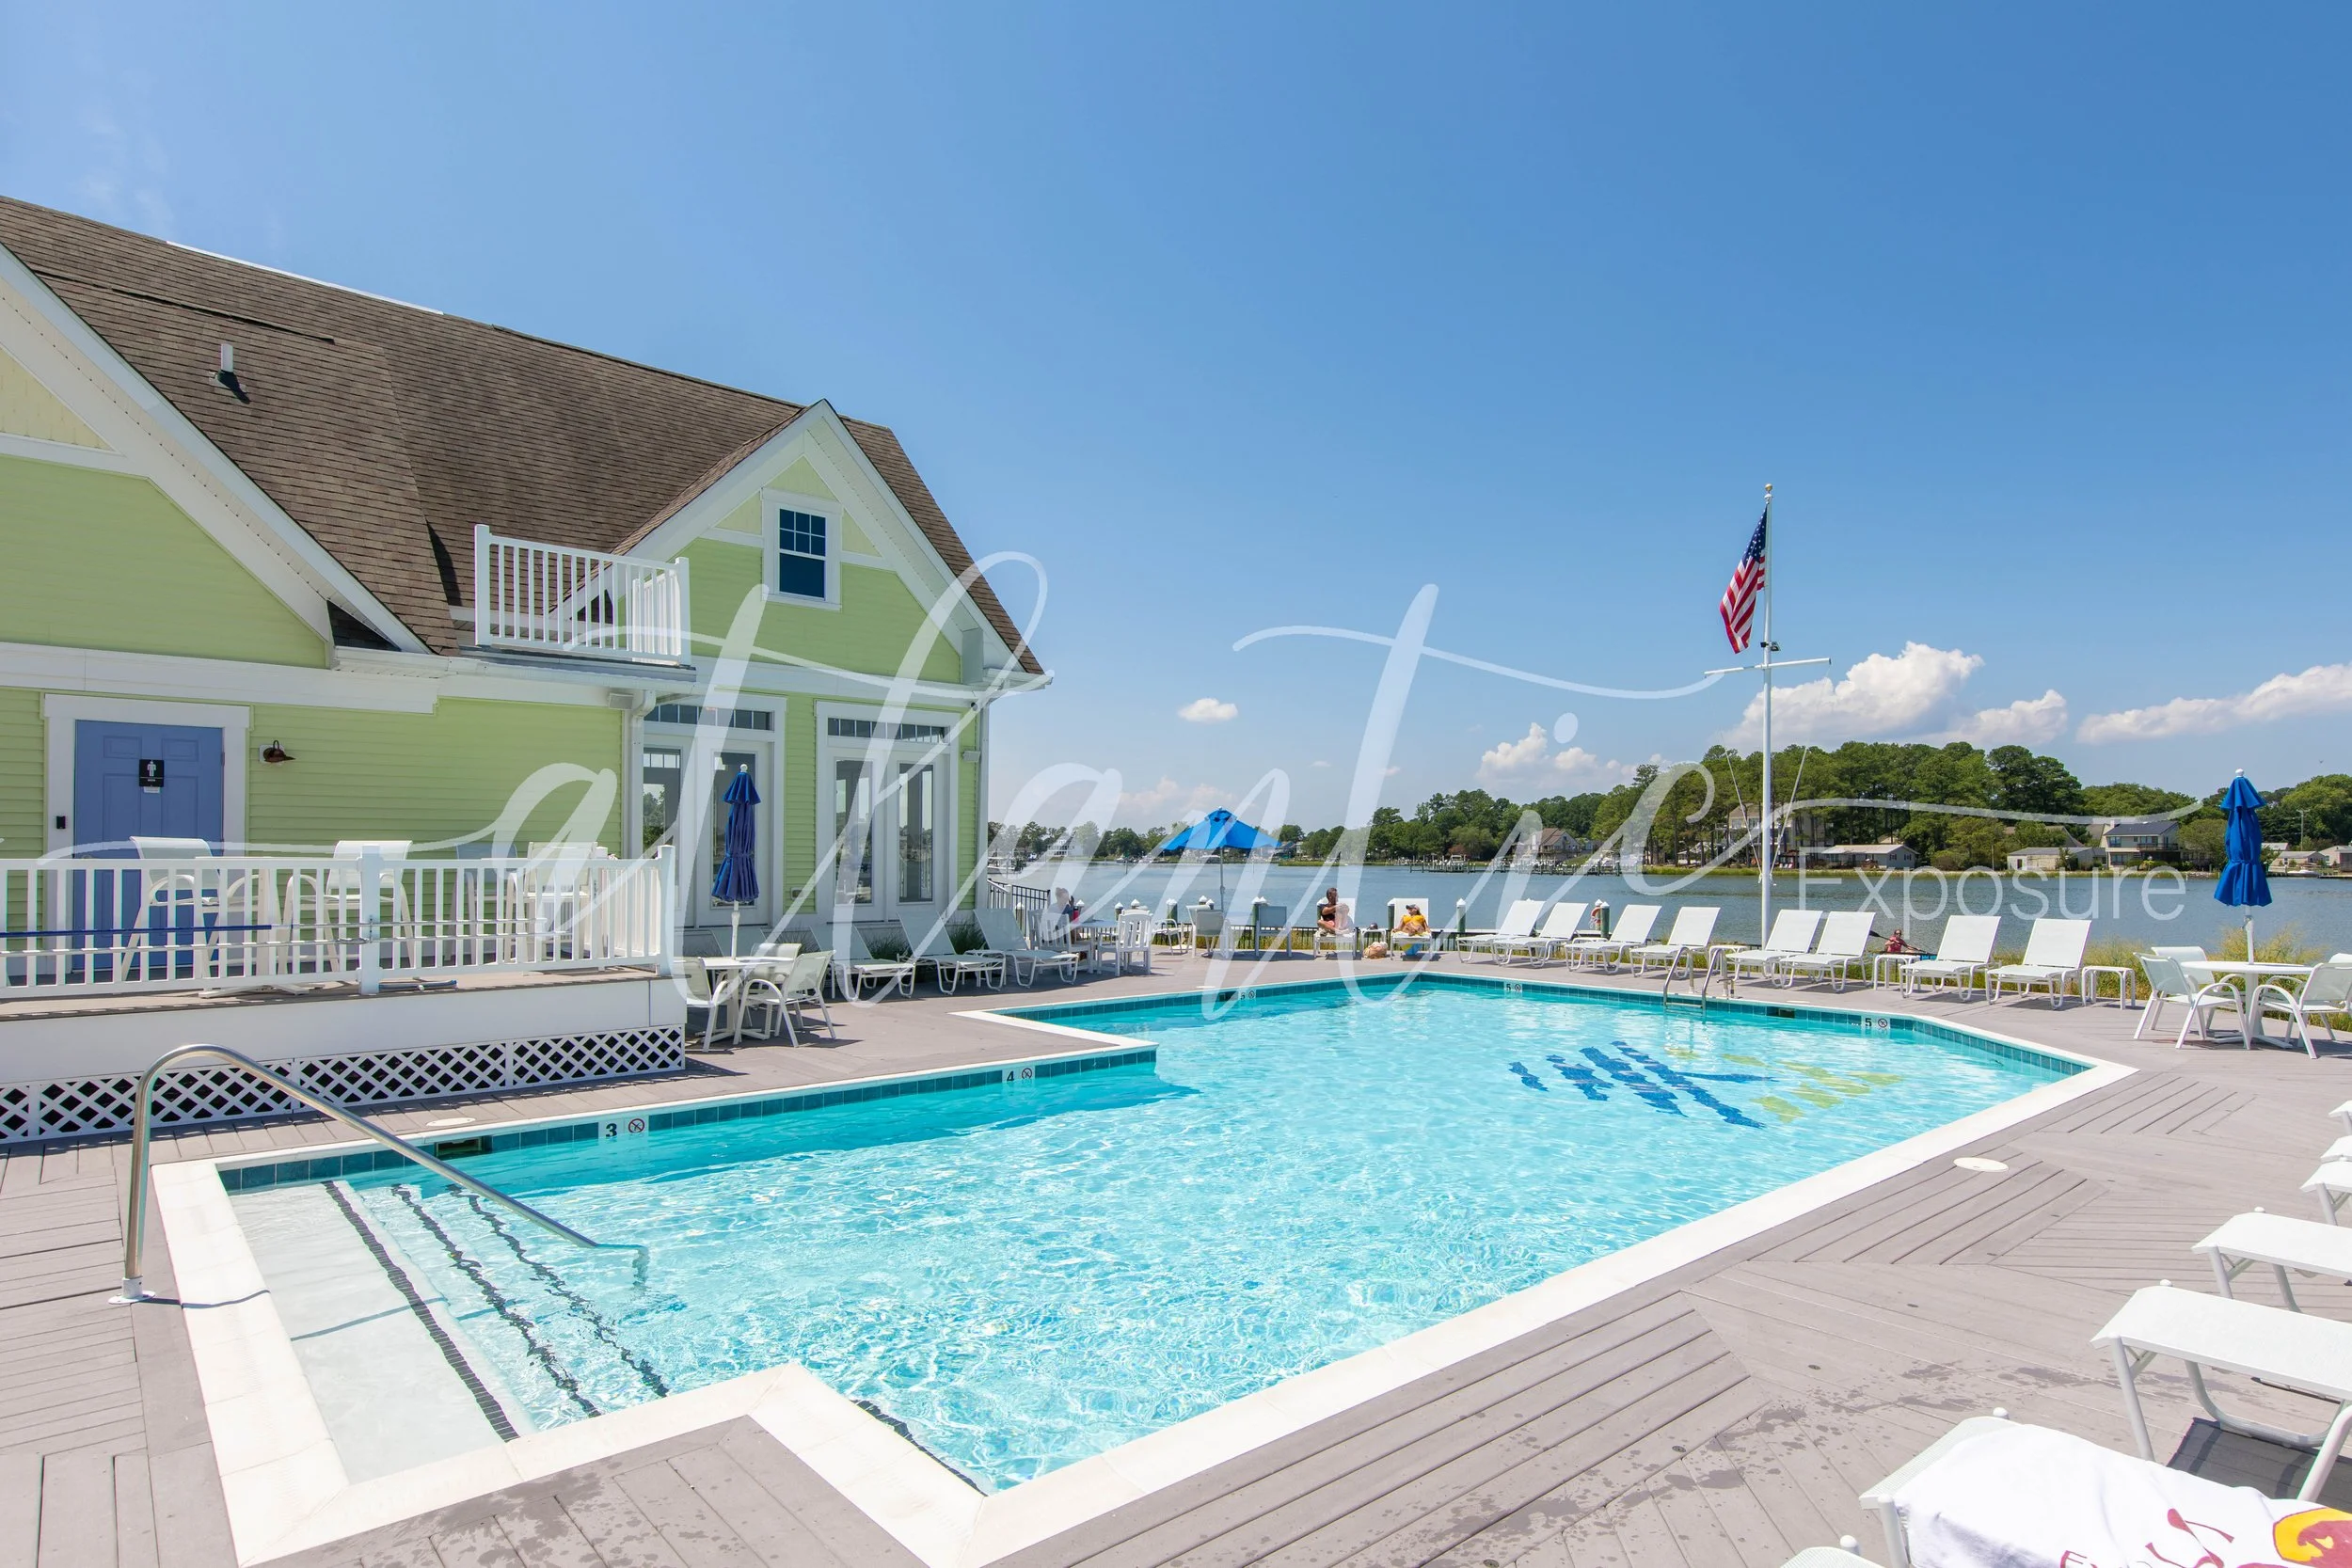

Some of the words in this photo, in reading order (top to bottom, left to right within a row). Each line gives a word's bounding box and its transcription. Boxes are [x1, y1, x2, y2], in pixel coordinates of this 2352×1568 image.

[1865, 1018, 1872, 1027] 5
[1006, 1070, 1014, 1081] 4
[605, 1123, 618, 1137] 3
